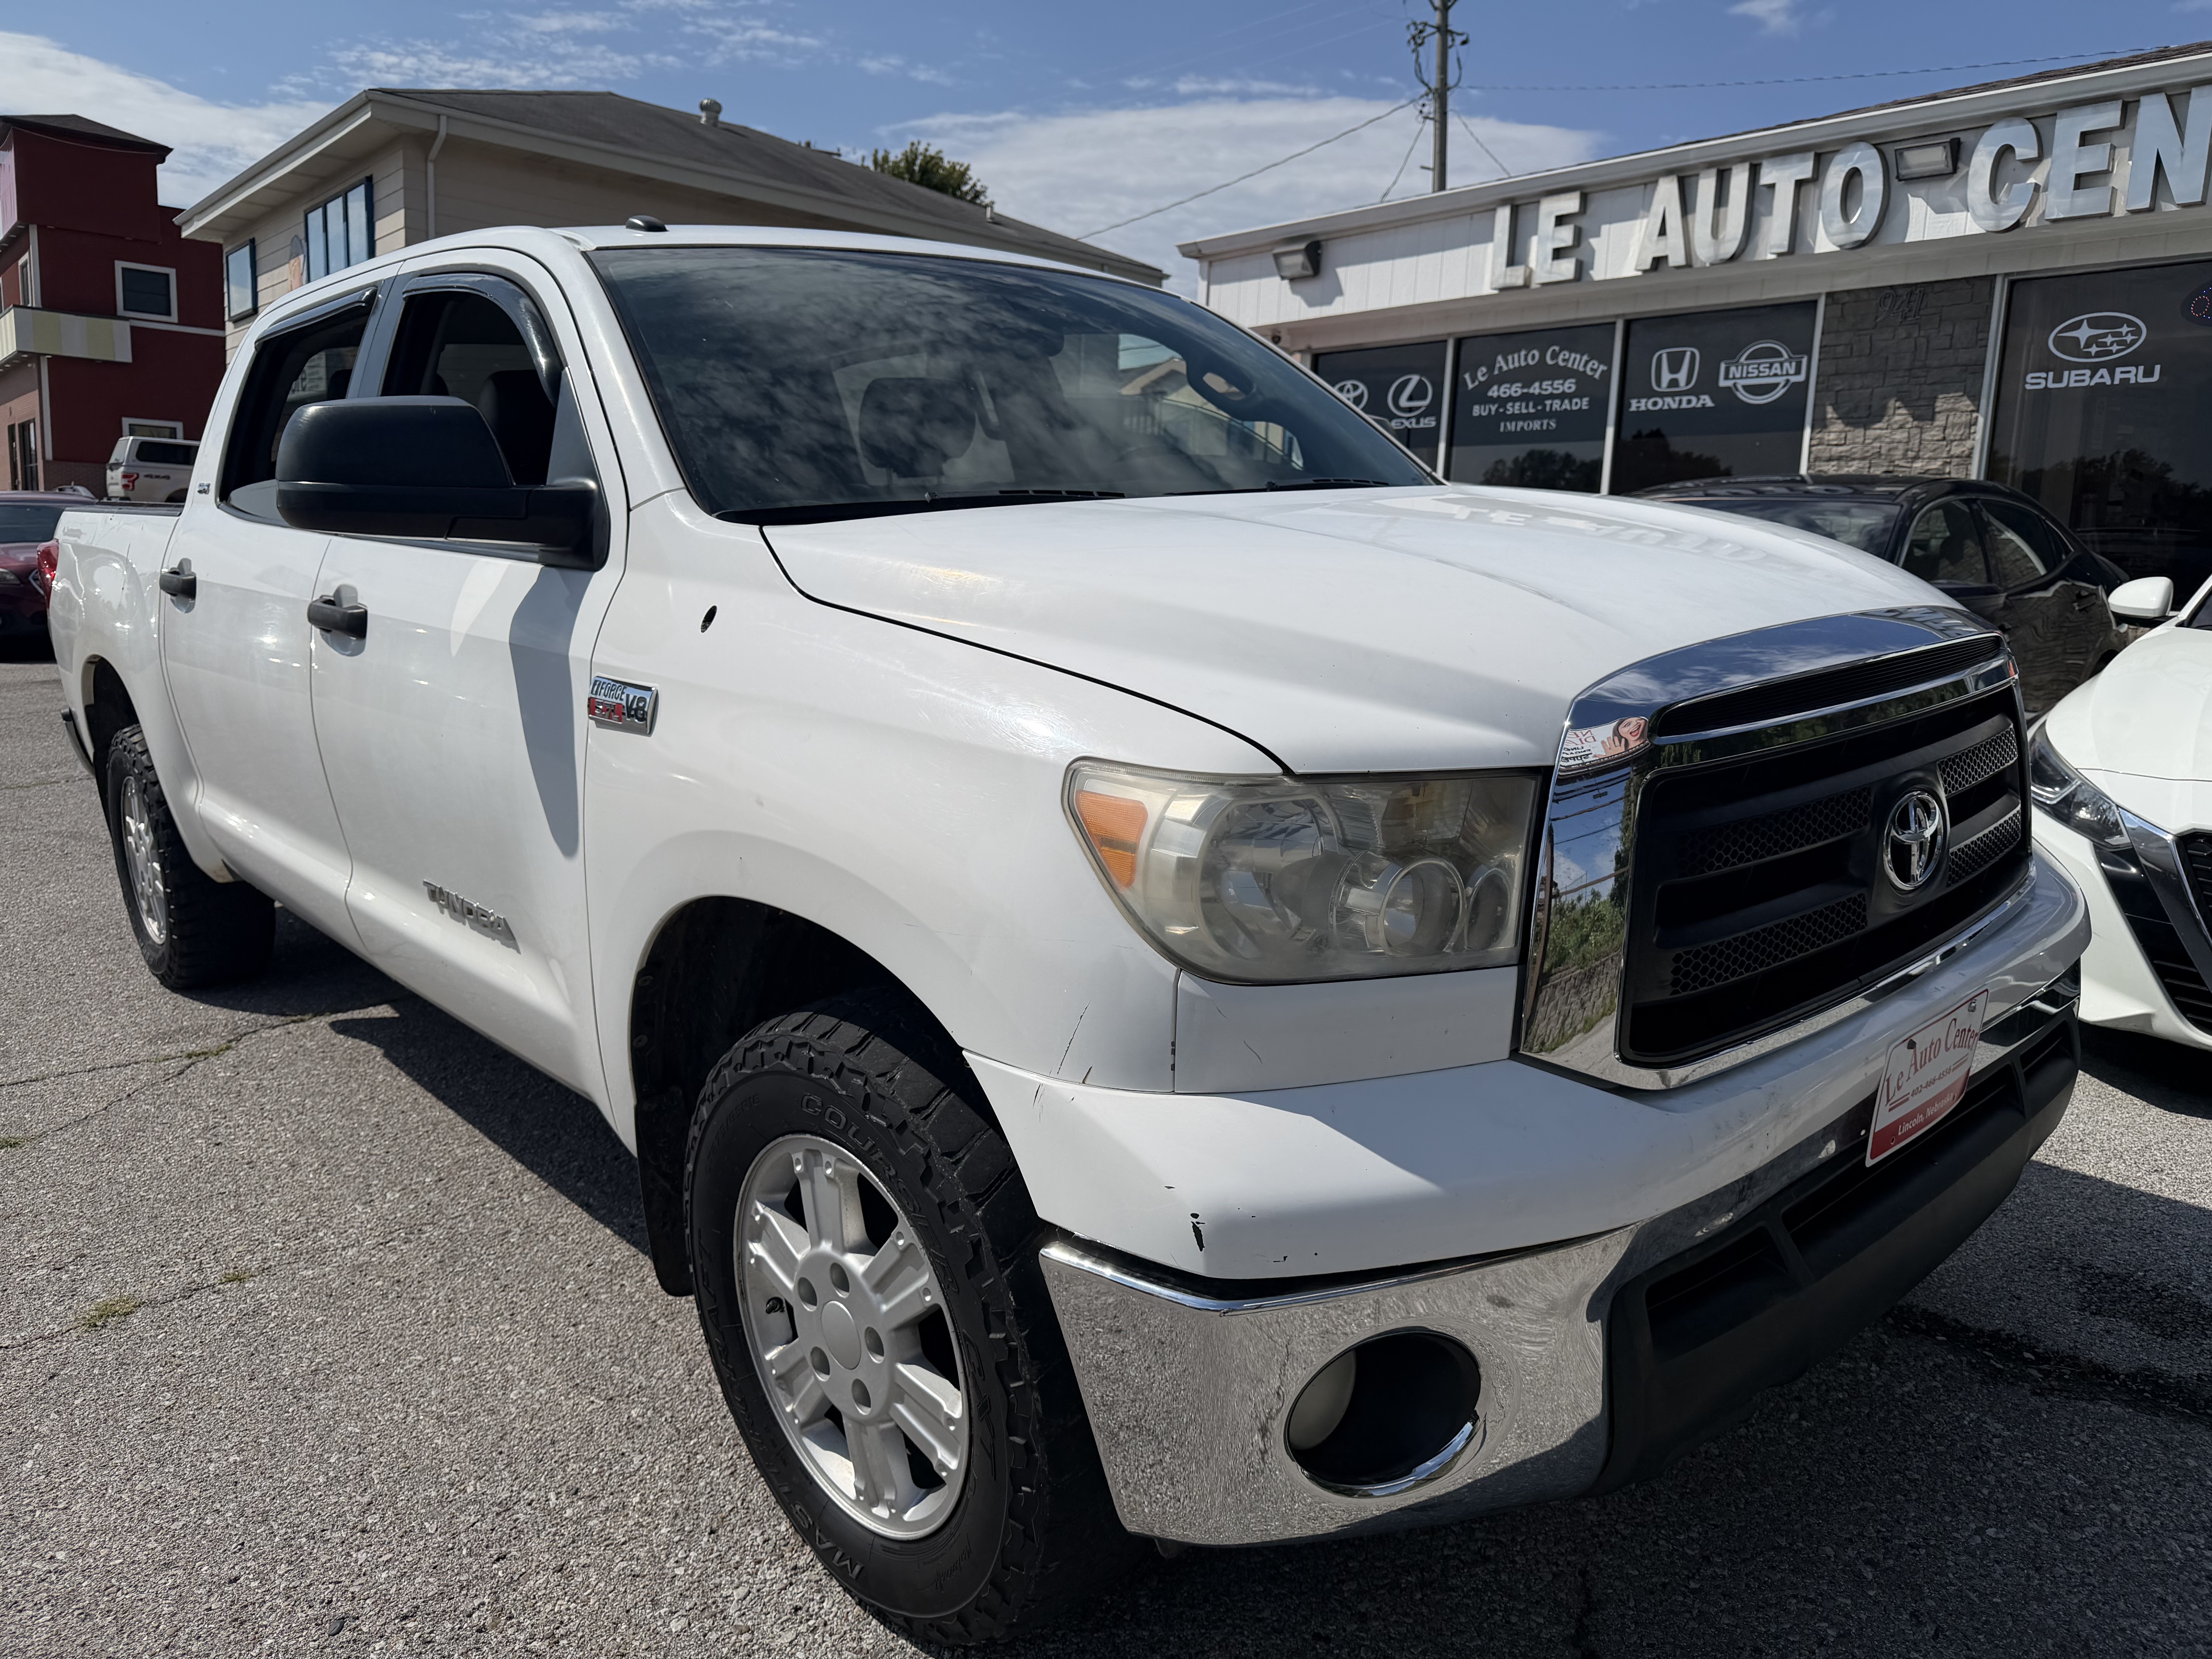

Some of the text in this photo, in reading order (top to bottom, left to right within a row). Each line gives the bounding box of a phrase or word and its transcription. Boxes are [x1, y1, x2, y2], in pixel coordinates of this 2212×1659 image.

[1490, 189, 1584, 292] LE
[1634, 140, 1890, 273] AUTO
[1876, 287, 1927, 324] 941
[1463, 345, 1608, 391] Le Auto Center
[1728, 361, 1797, 379] NISSAN
[2024, 364, 2161, 390] SUBARU
[1487, 378, 1577, 398] 466-4556
[1628, 394, 1716, 412] HONDA
[1391, 416, 1437, 429] EXUS
[1499, 419, 1557, 433] IMPORTS
[625, 693, 647, 723] V8
[422, 878, 517, 942] TUNDRA
[1885, 1018, 1979, 1106] Le Auto Center
[1910, 1065, 1952, 1099] 402-466-4556
[1898, 1092, 1955, 1136] Lincoln, Nebraska
[801, 1093, 960, 1294] COURSER
